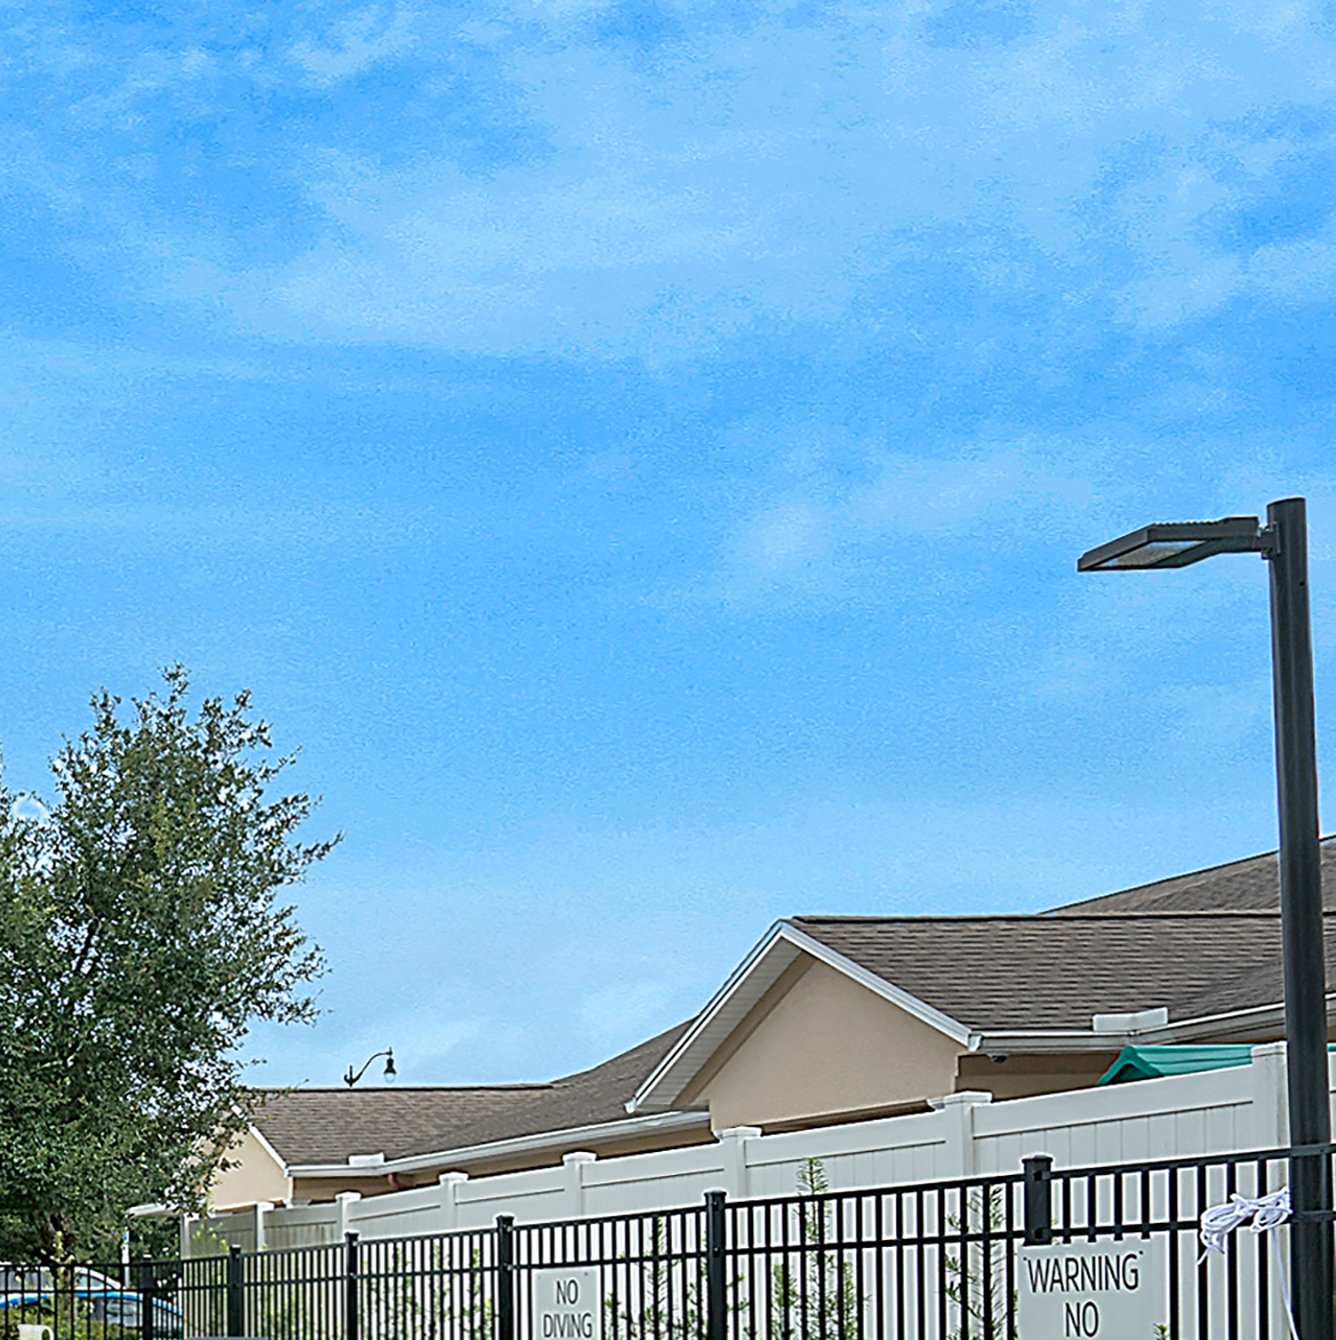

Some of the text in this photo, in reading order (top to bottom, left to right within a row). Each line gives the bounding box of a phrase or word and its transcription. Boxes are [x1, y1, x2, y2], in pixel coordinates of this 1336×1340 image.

[1028, 1254, 1139, 1292] WARNING
[556, 1279, 579, 1305] NO
[543, 1312, 593, 1339] DIVING
[1065, 1301, 1099, 1338] NO
